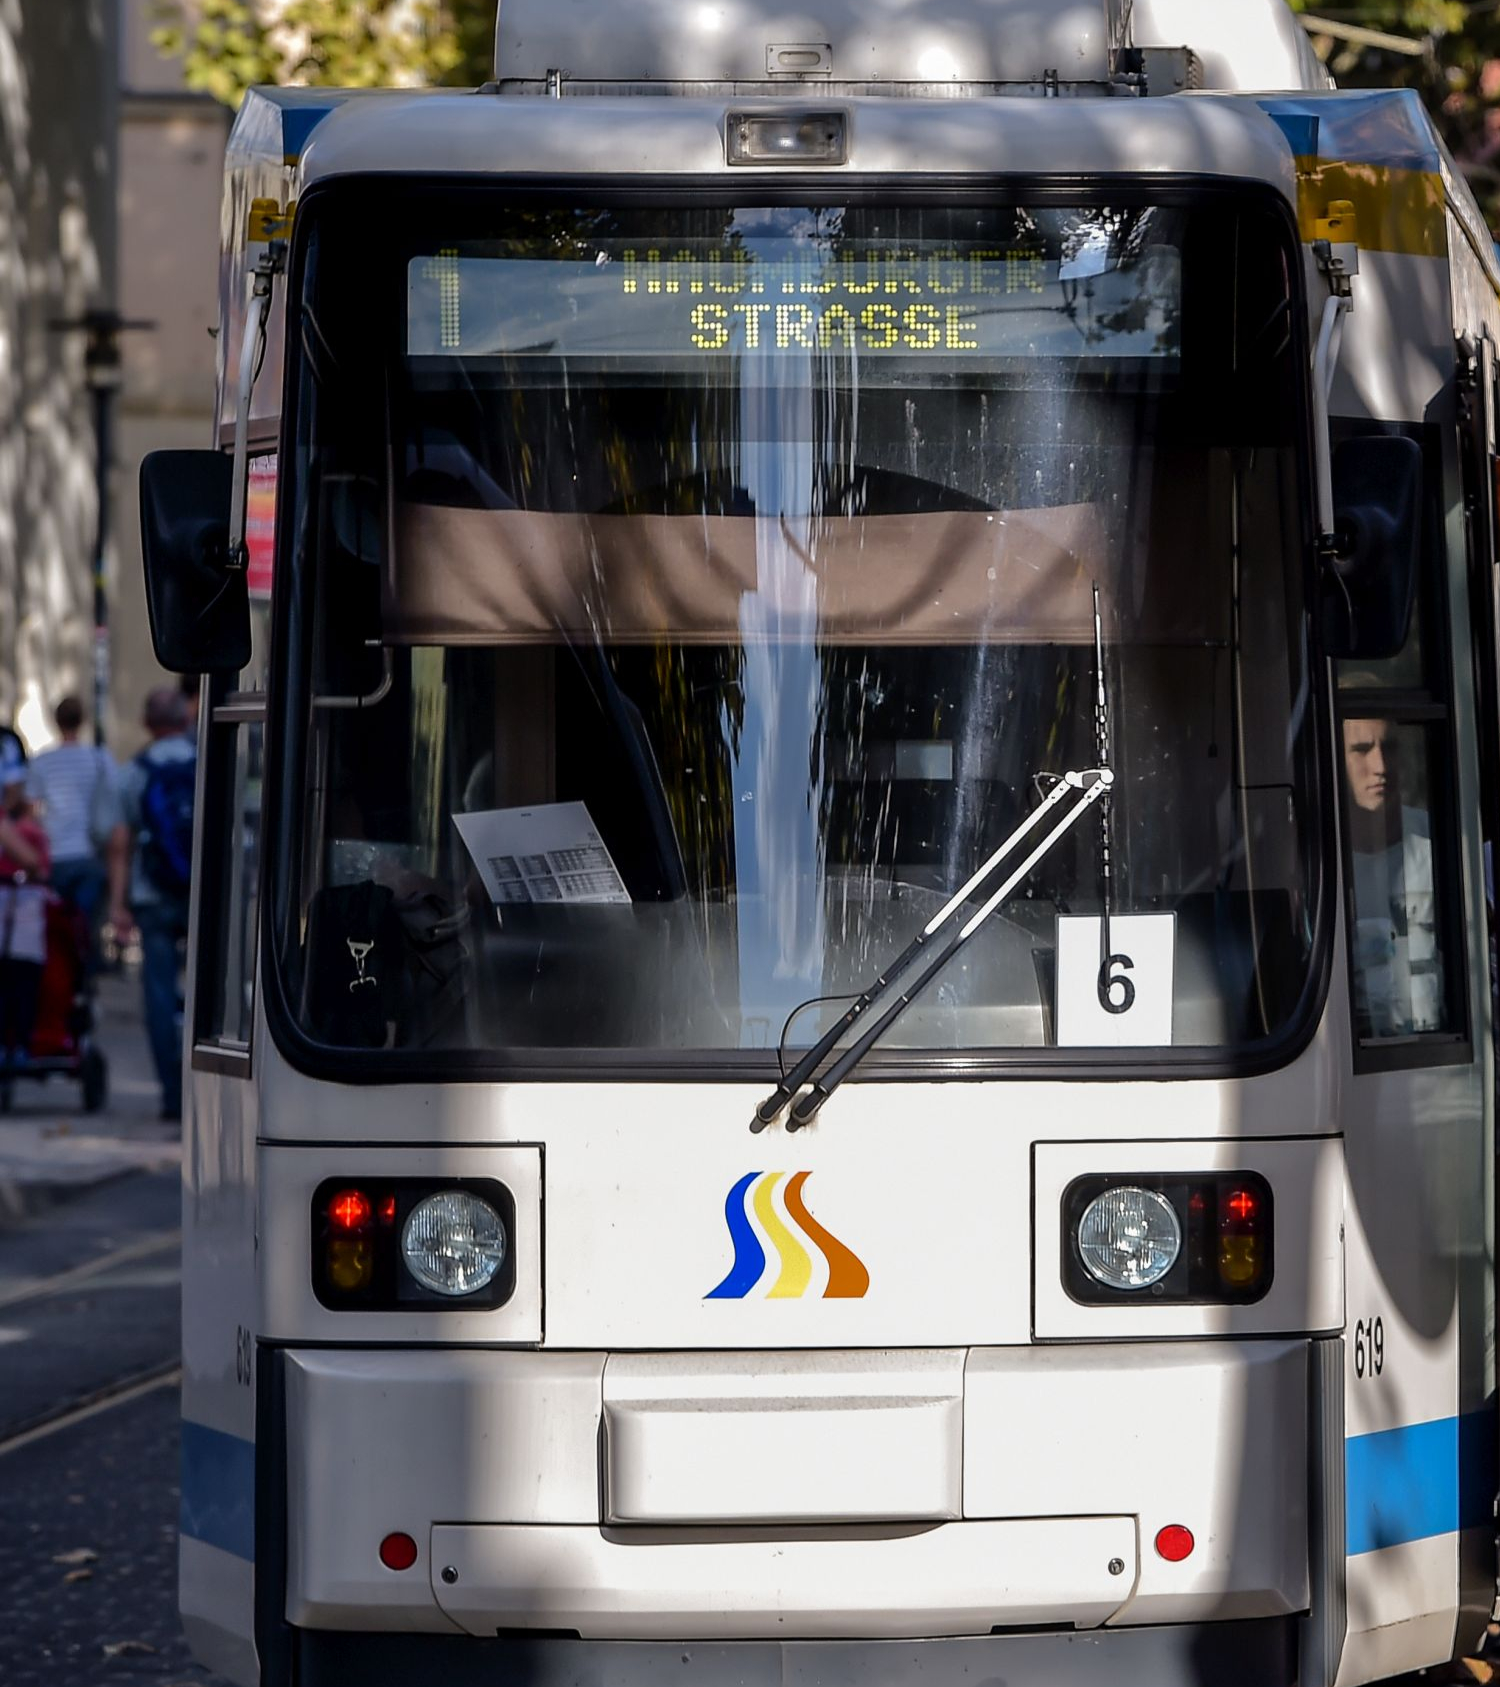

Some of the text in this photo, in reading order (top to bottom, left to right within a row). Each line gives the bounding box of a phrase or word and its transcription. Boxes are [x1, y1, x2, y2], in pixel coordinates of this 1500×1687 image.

[690, 303, 979, 349] STRASSE
[1097, 953, 1136, 1015] 6
[1355, 1316, 1384, 1379] 619
